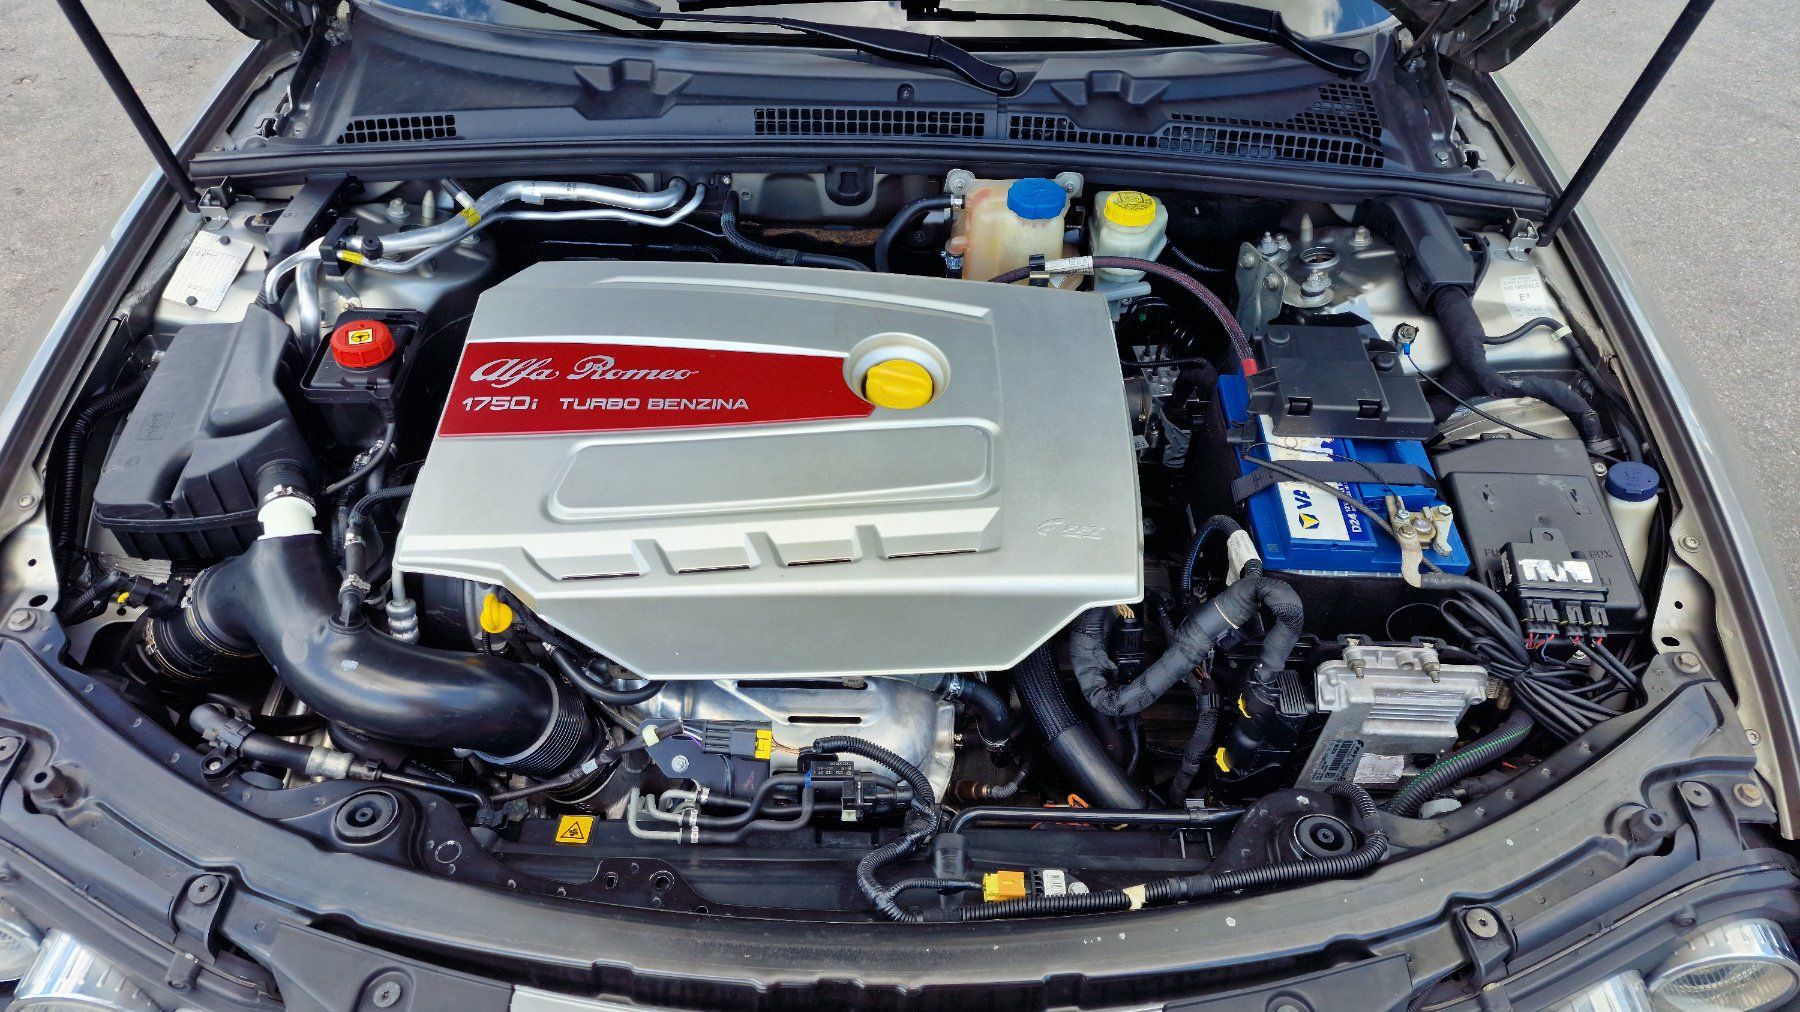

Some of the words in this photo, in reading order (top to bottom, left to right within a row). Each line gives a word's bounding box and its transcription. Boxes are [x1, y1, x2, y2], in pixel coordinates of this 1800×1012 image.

[469, 357, 559, 388] Alfa
[566, 355, 699, 380] Romeo
[462, 396, 539, 411] 1750i
[559, 397, 640, 410] TURBO
[647, 398, 750, 410] BENZINA
[1348, 513, 1362, 532] D24
[1589, 549, 1613, 558] BOX
